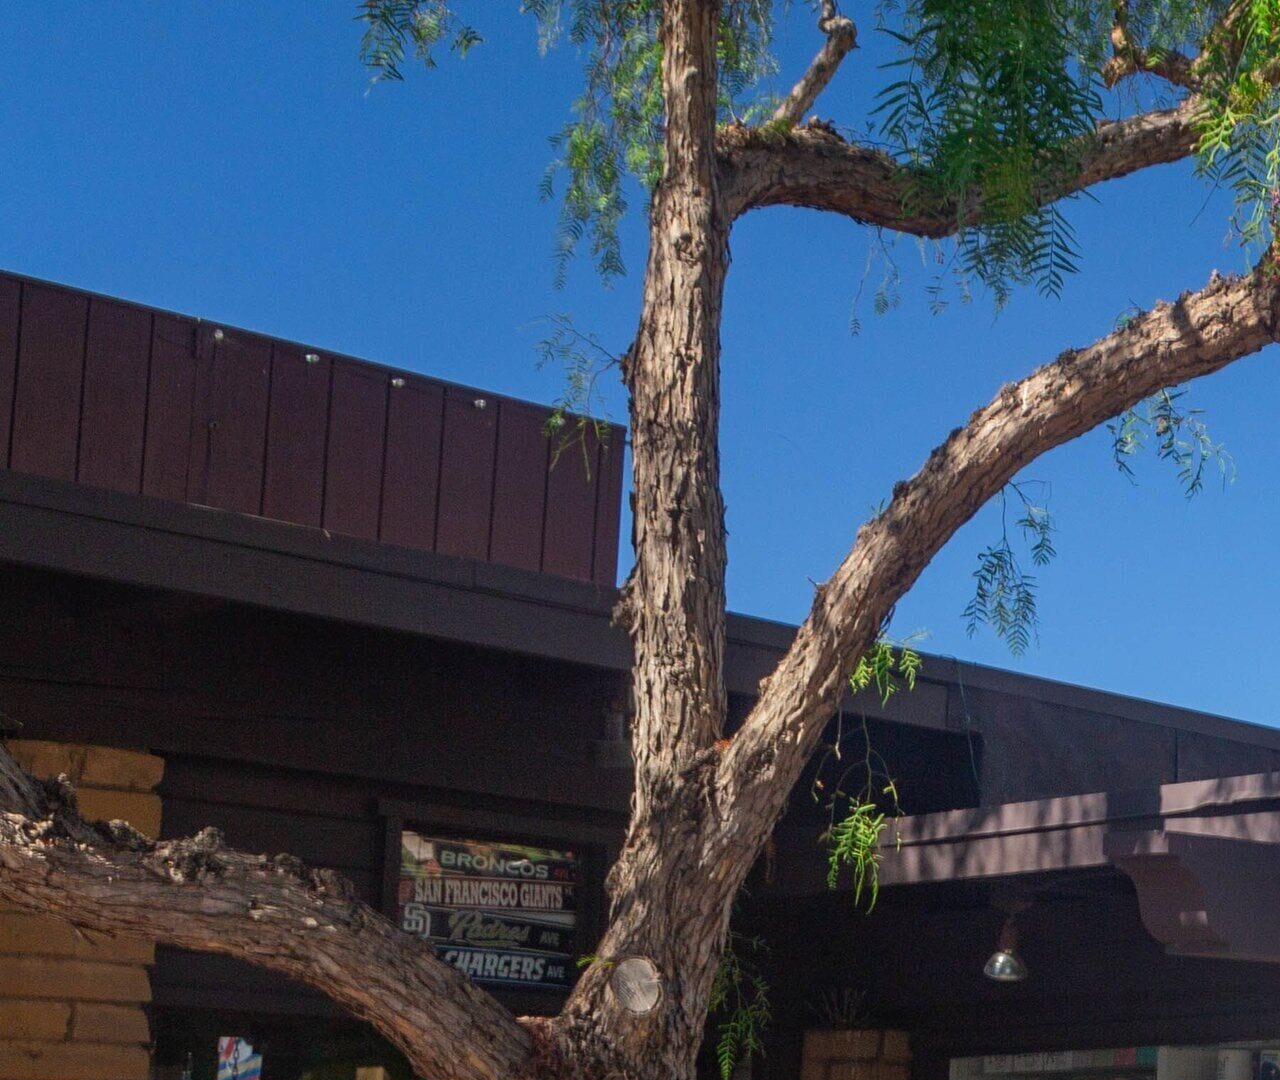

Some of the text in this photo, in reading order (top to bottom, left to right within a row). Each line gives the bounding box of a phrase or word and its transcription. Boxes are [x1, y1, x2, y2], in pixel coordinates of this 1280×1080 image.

[440, 850, 549, 879] BRONCOS
[415, 879, 564, 909] SAN FRANCISCO GIANTS
[448, 909, 560, 946] Padres AVE
[547, 964, 565, 978] AVE
